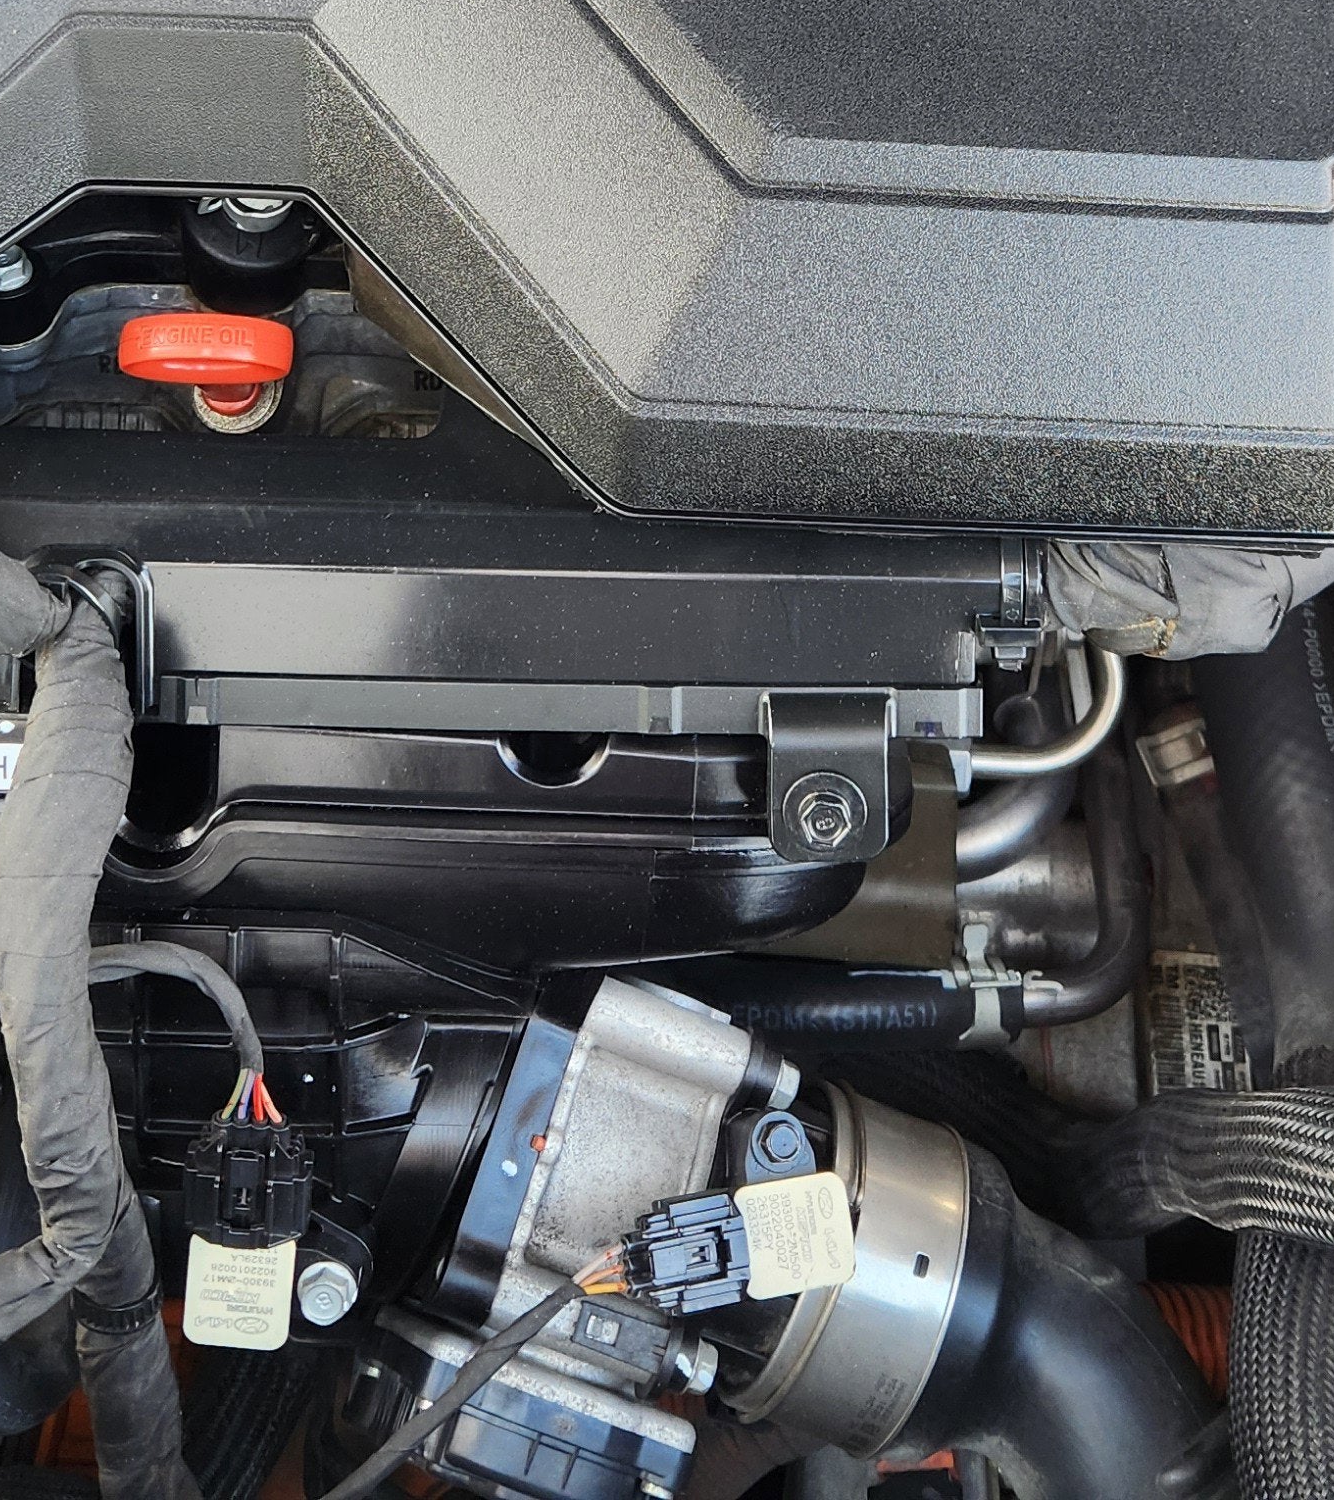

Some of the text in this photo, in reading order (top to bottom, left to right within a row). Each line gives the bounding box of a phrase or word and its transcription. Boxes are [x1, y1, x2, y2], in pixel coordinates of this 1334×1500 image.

[139, 322, 253, 350] ENGINE OIL
[756, 1195, 774, 1251] 26315PY
[768, 1193, 788, 1271] 9022040027
